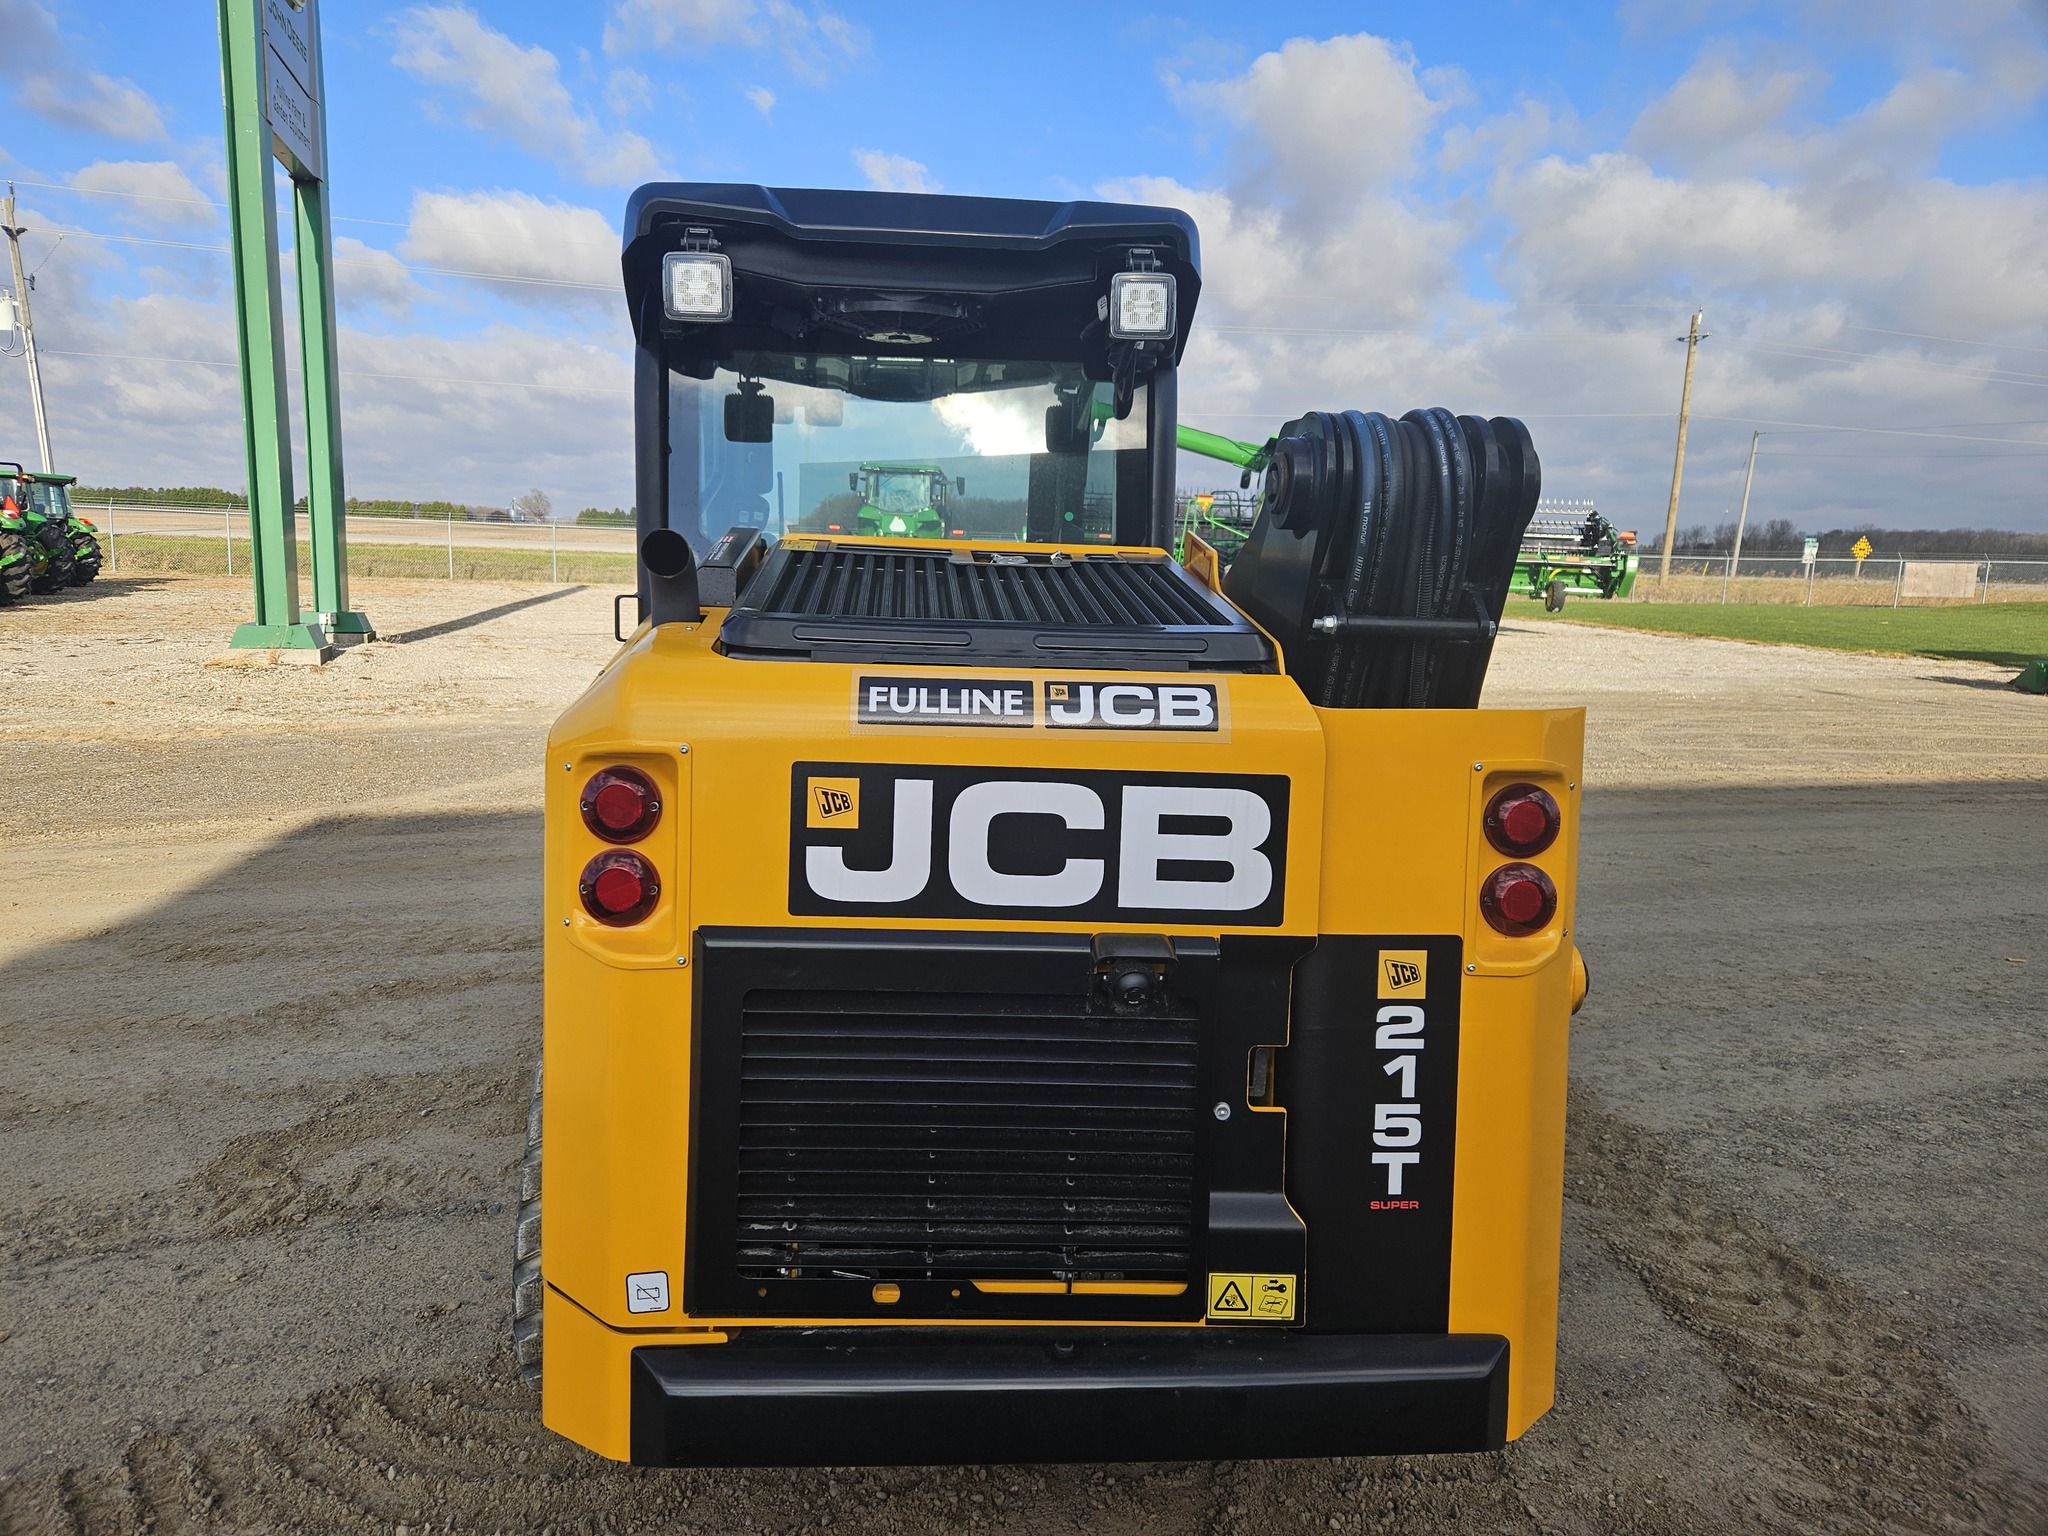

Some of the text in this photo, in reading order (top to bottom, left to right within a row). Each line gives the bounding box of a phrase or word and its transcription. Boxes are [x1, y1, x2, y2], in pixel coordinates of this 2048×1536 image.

[287, 17, 307, 63] DEERE
[868, 685, 1214, 726] FULLINE JCB
[821, 791, 852, 816] JCB
[805, 778, 1273, 911] JCB
[1391, 963, 1420, 986] JCB
[1371, 1005, 1426, 1195] 215T
[1370, 1200, 1420, 1210] SUPER
